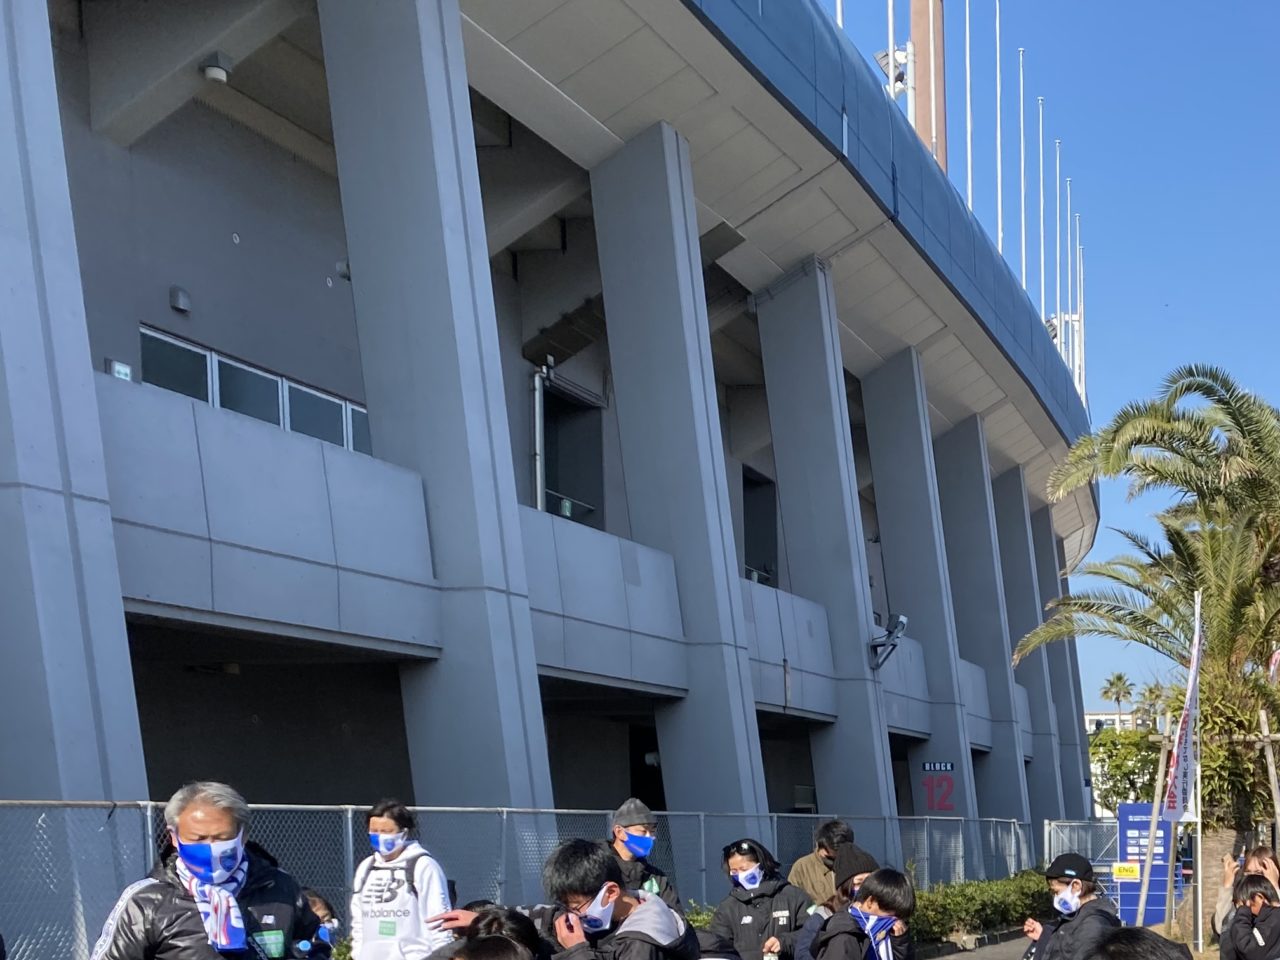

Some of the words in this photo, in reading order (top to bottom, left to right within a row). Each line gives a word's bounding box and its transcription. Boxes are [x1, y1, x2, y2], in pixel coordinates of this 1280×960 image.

[924, 762, 952, 771] BLOCK
[921, 772, 956, 811] 12
[1118, 866, 1134, 874] ENG
